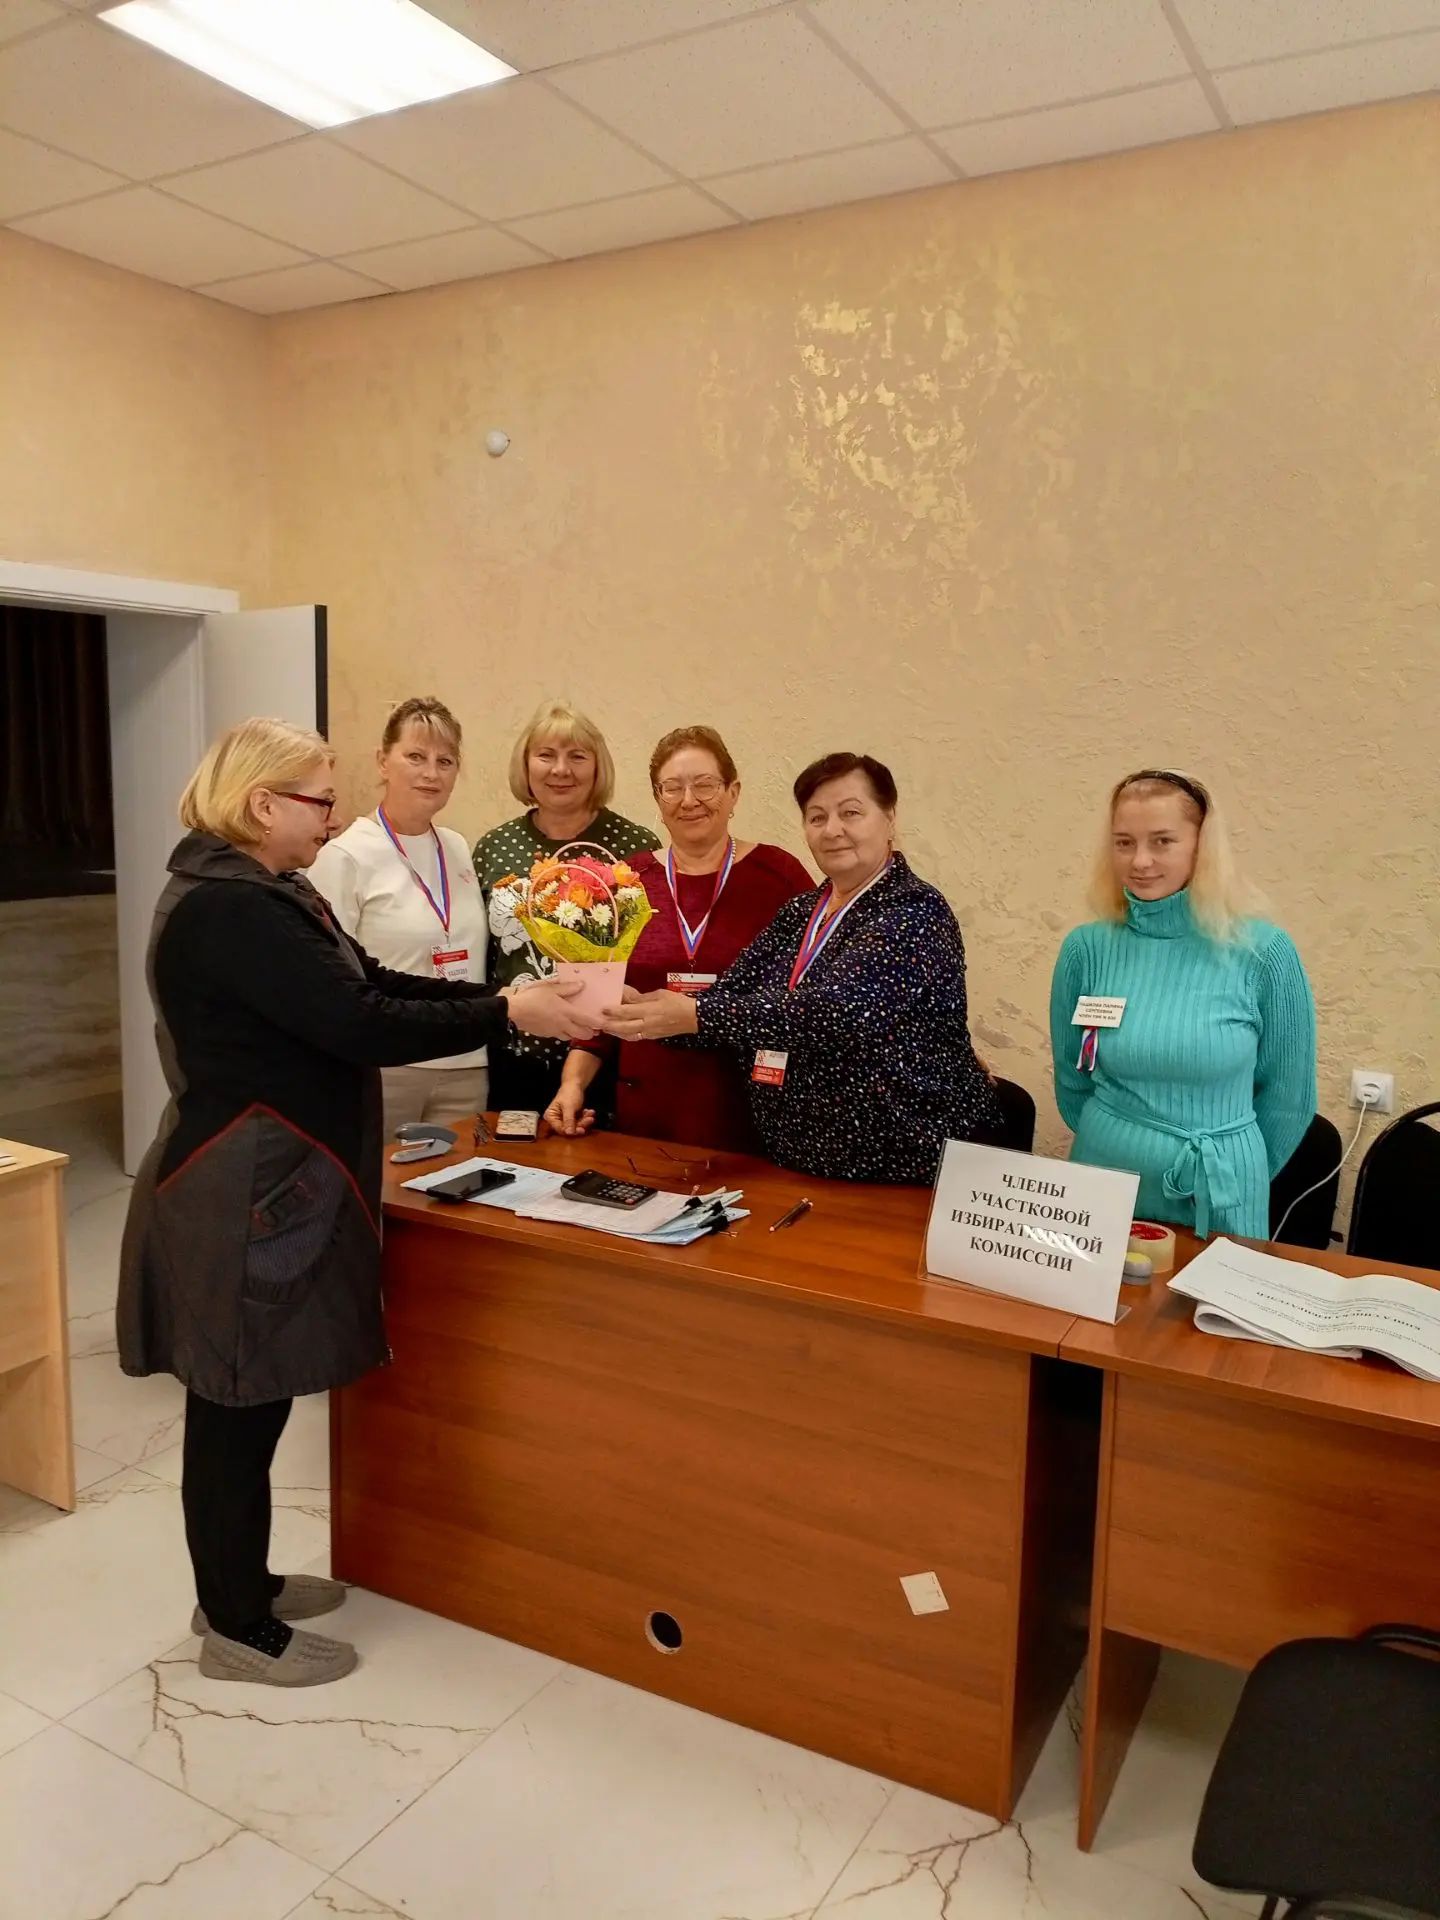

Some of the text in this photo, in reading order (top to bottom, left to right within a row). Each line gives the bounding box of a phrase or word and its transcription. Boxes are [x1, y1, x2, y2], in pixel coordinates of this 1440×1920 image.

[1002, 1173, 1067, 1198] ЧЛЕНЫ
[970, 1190, 1092, 1227] УЧАСТКОВОЙ
[951, 1208, 1103, 1254] ИЗБИРАТОЙ
[970, 1236, 1073, 1272] КОМИССИИ
